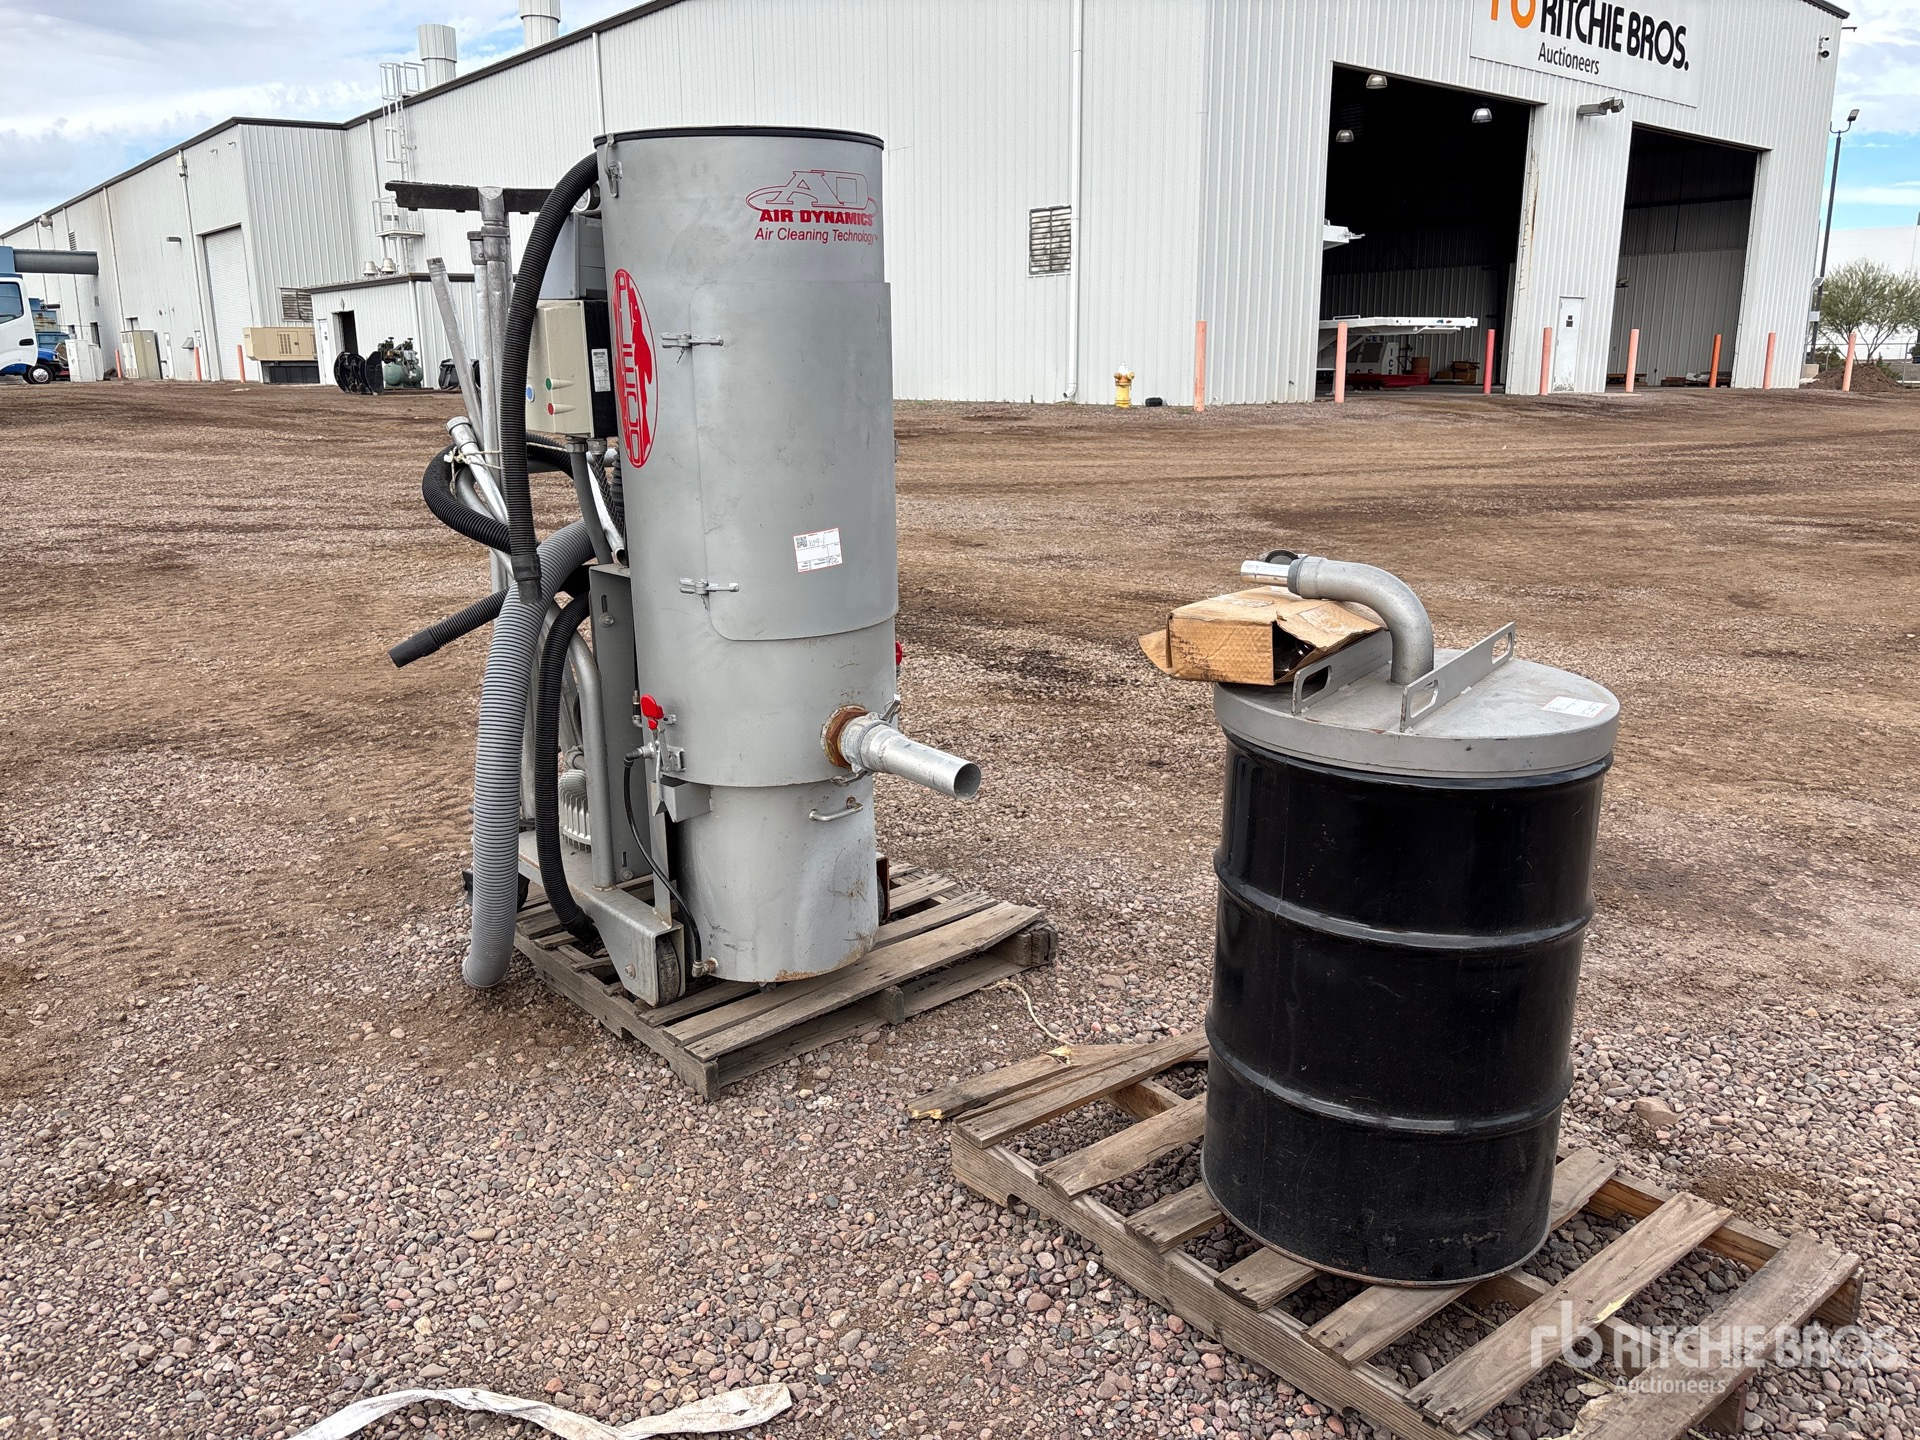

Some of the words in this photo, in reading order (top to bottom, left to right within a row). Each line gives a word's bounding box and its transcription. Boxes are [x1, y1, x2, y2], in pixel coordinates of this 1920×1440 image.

[1540, 0, 1624, 52] RITCHIE
[1627, 11, 1689, 71] BROS.
[1538, 42, 1600, 75] Auctioneers
[759, 209, 794, 223] AIR
[800, 209, 873, 226] DYNAMICS
[754, 227, 774, 241] Air
[777, 228, 829, 244] Cleaning
[832, 229, 873, 246] Technology
